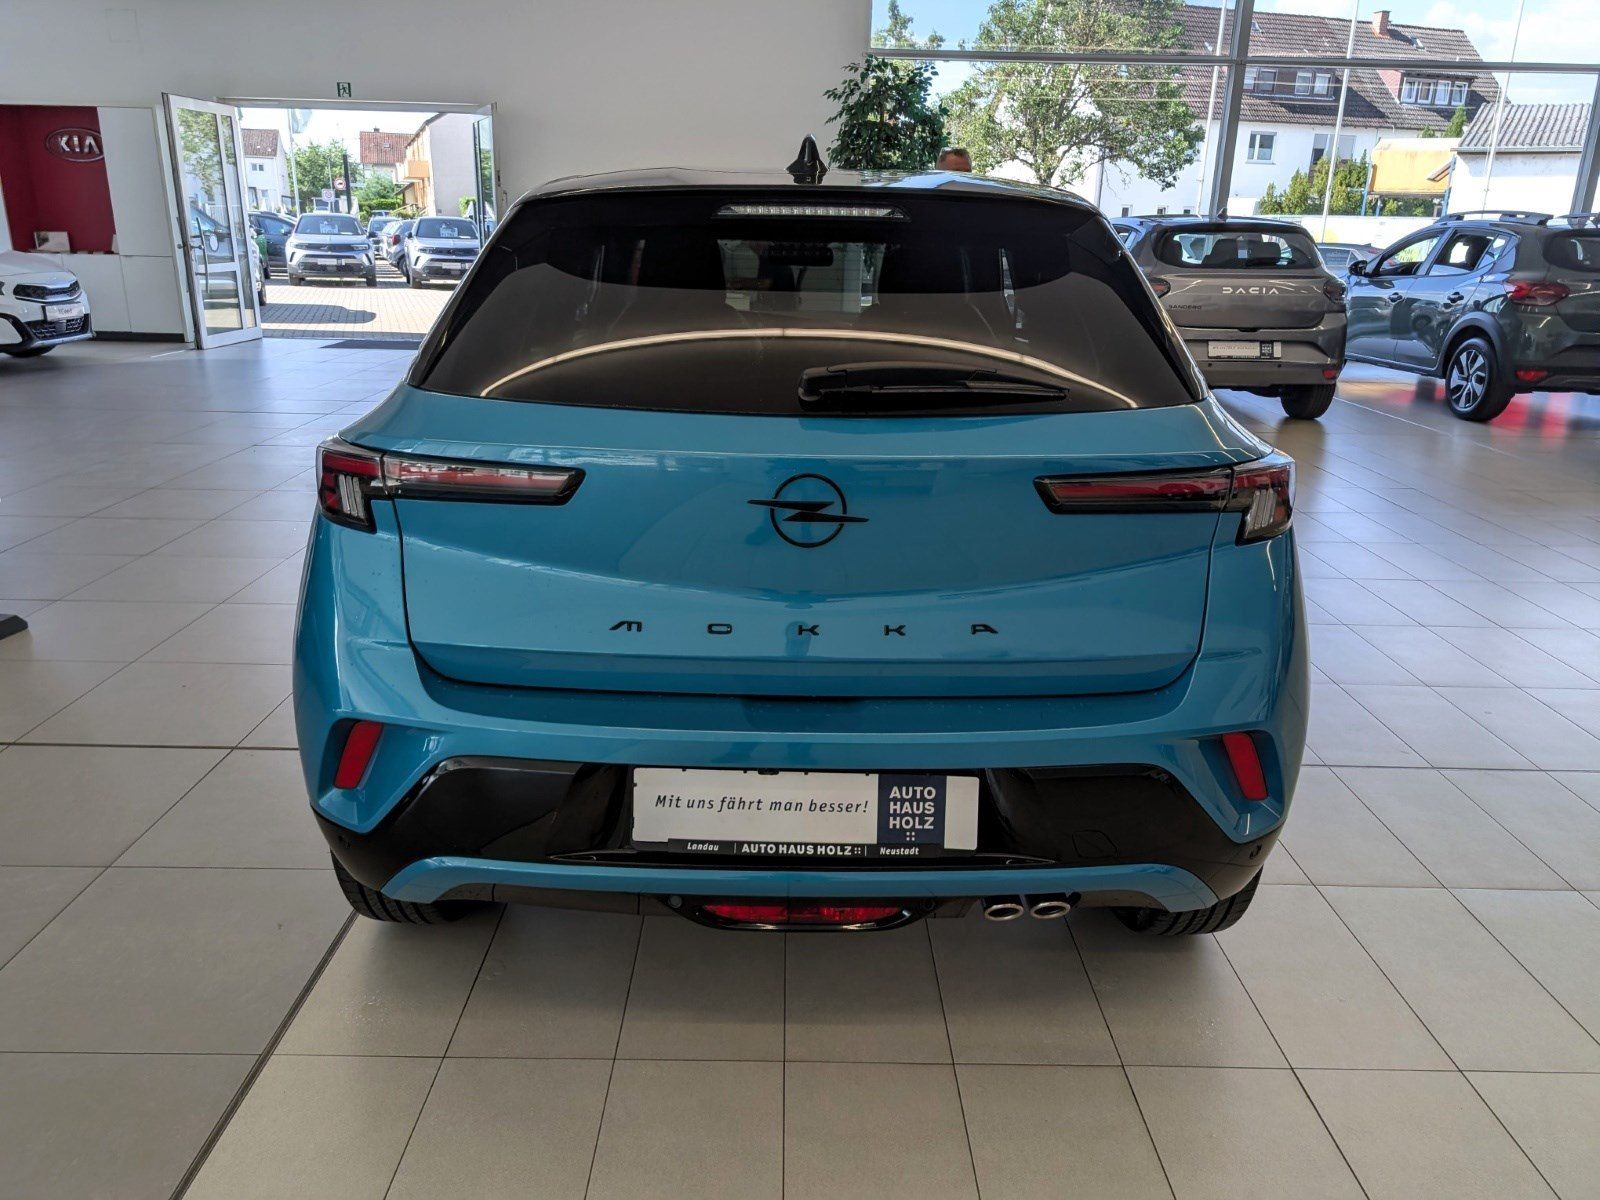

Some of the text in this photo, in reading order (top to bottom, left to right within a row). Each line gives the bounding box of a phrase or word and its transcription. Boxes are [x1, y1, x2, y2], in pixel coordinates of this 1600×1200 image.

[58, 135, 100, 154] KIA
[608, 619, 999, 637] MOKKA
[889, 786, 936, 799] AUTO
[655, 795, 869, 813] Mit uns fährt man besser!
[889, 801, 935, 814] HAUS
[889, 816, 935, 829] HOLZ
[687, 842, 719, 851] Landau
[741, 843, 852, 856] AUTO HAUS HOLZ
[879, 846, 919, 855] Neustadt
